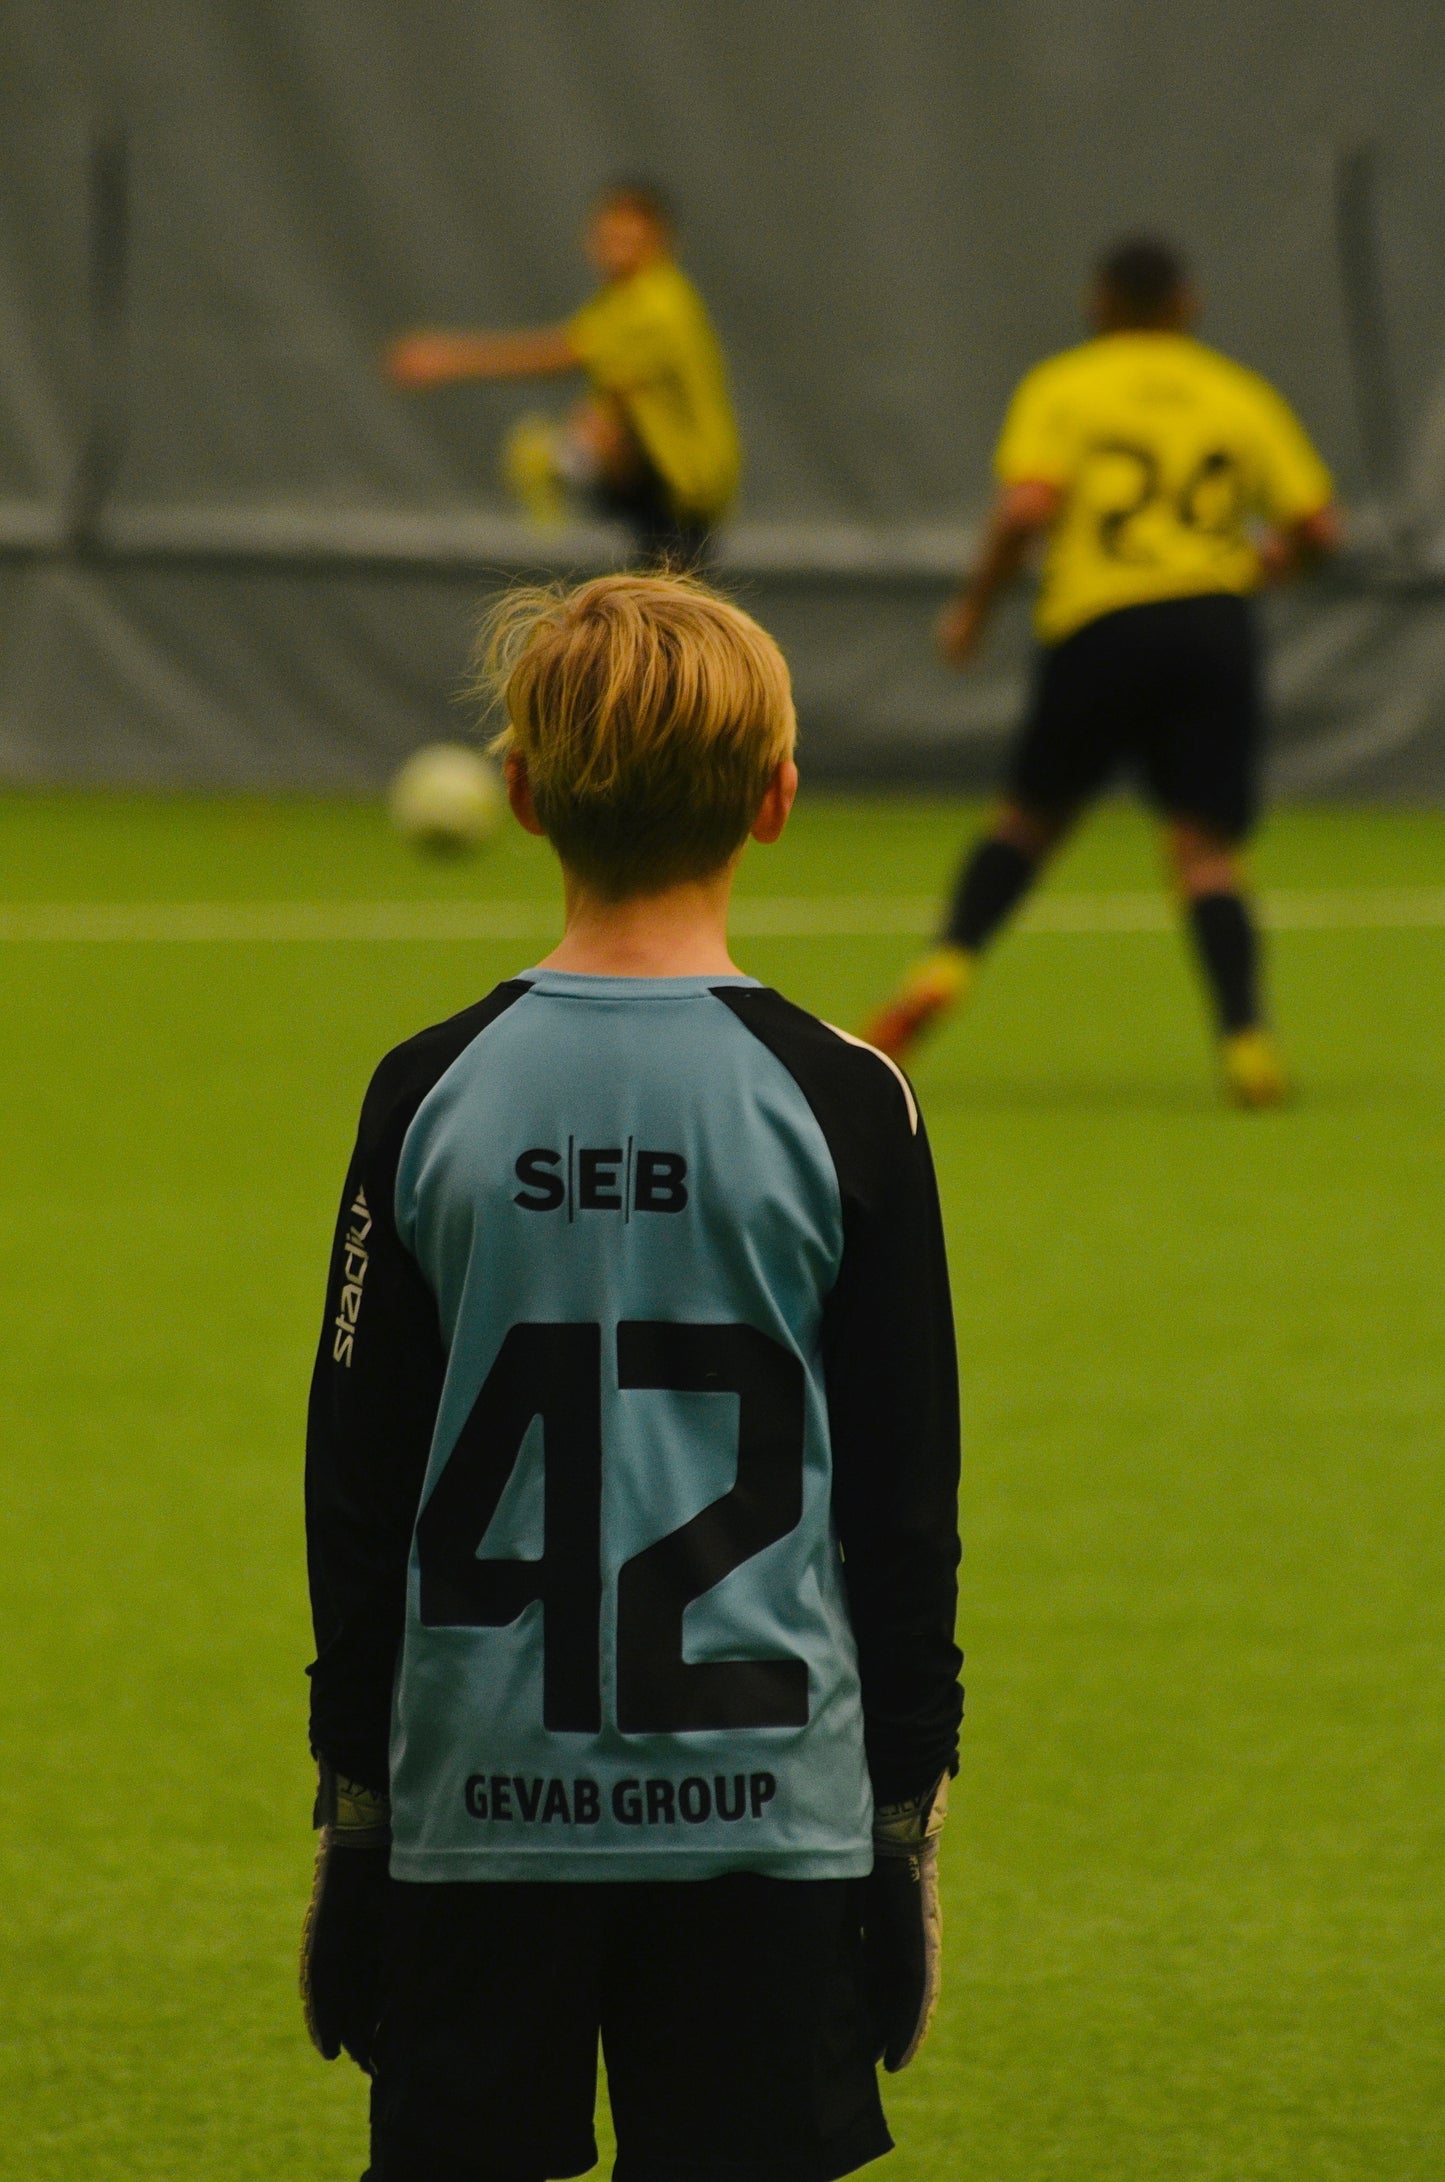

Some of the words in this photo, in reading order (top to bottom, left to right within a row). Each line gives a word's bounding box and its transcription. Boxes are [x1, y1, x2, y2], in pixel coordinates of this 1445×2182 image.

[418, 1322, 808, 1733] 42
[464, 1774, 601, 1825] GEVAB
[611, 1772, 776, 1826] GROUP
